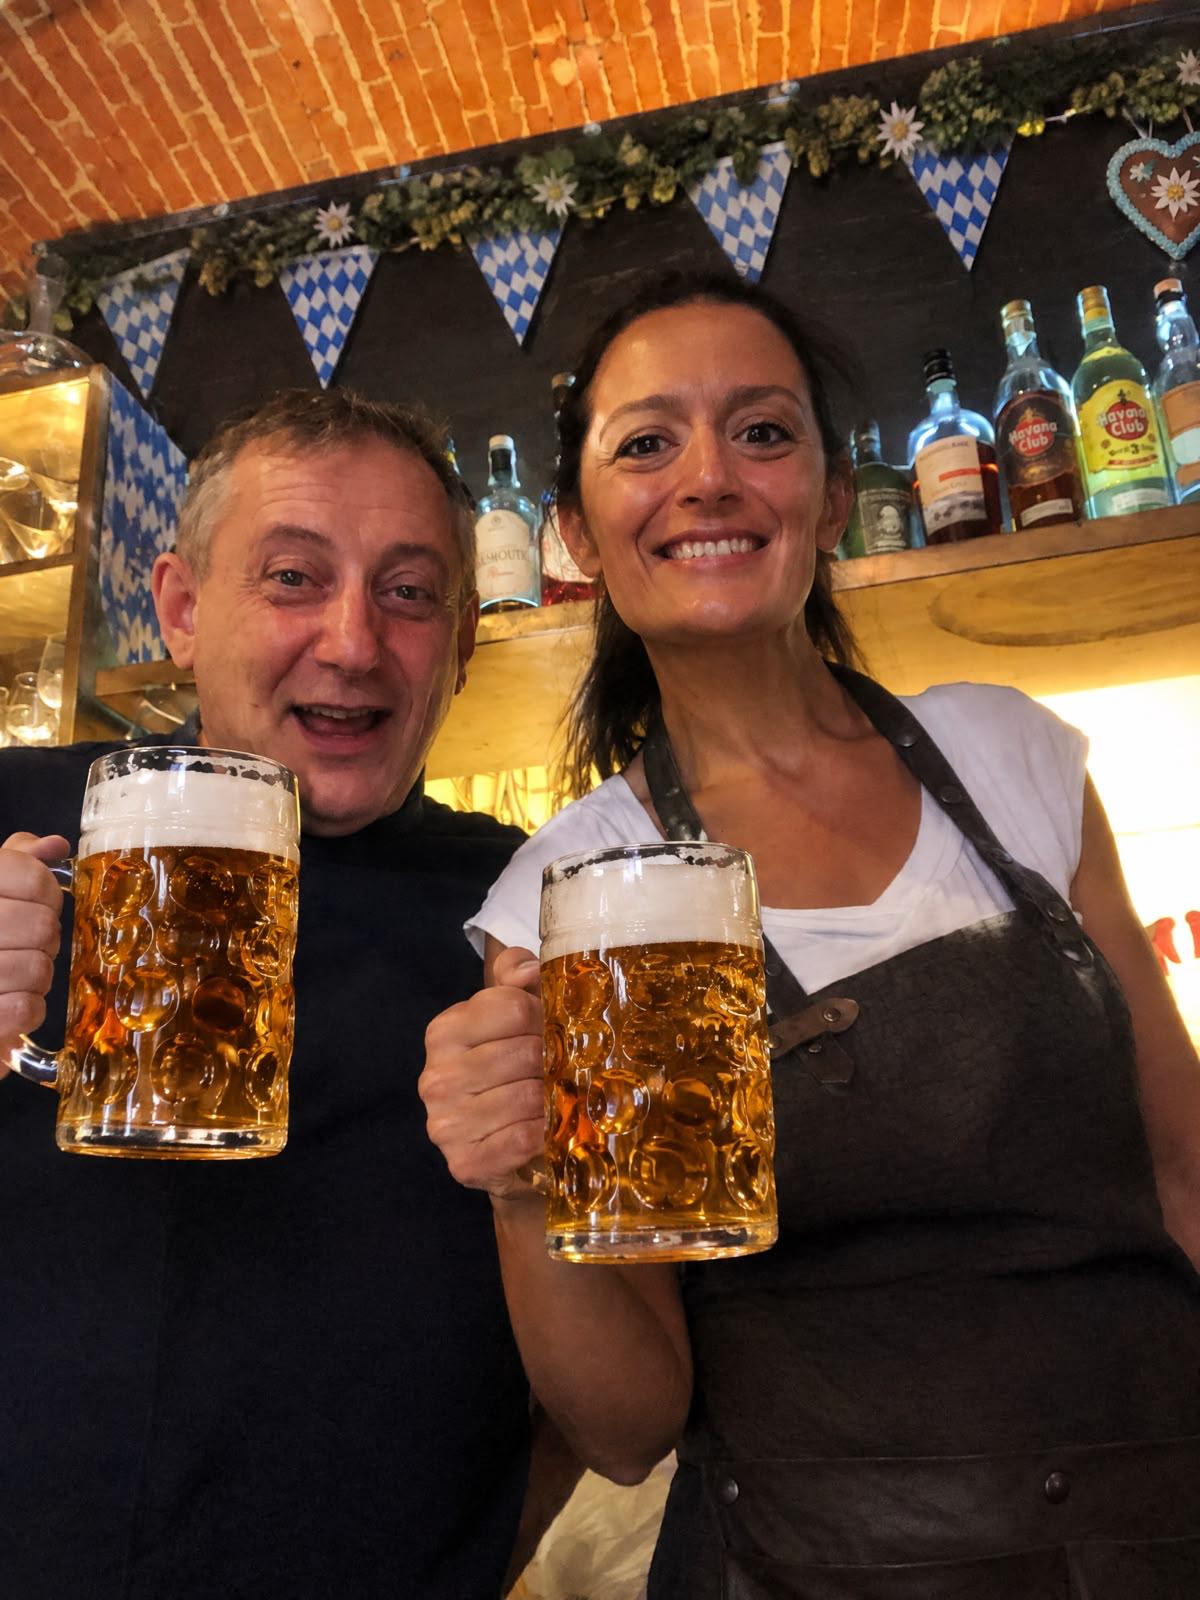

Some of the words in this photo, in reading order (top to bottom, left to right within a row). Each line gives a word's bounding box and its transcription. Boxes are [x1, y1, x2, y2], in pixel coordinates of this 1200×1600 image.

[1097, 408, 1146, 427] Havana
[1008, 422, 1057, 446] Havana
[1111, 419, 1144, 436] Club
[1019, 434, 1049, 451] Club
